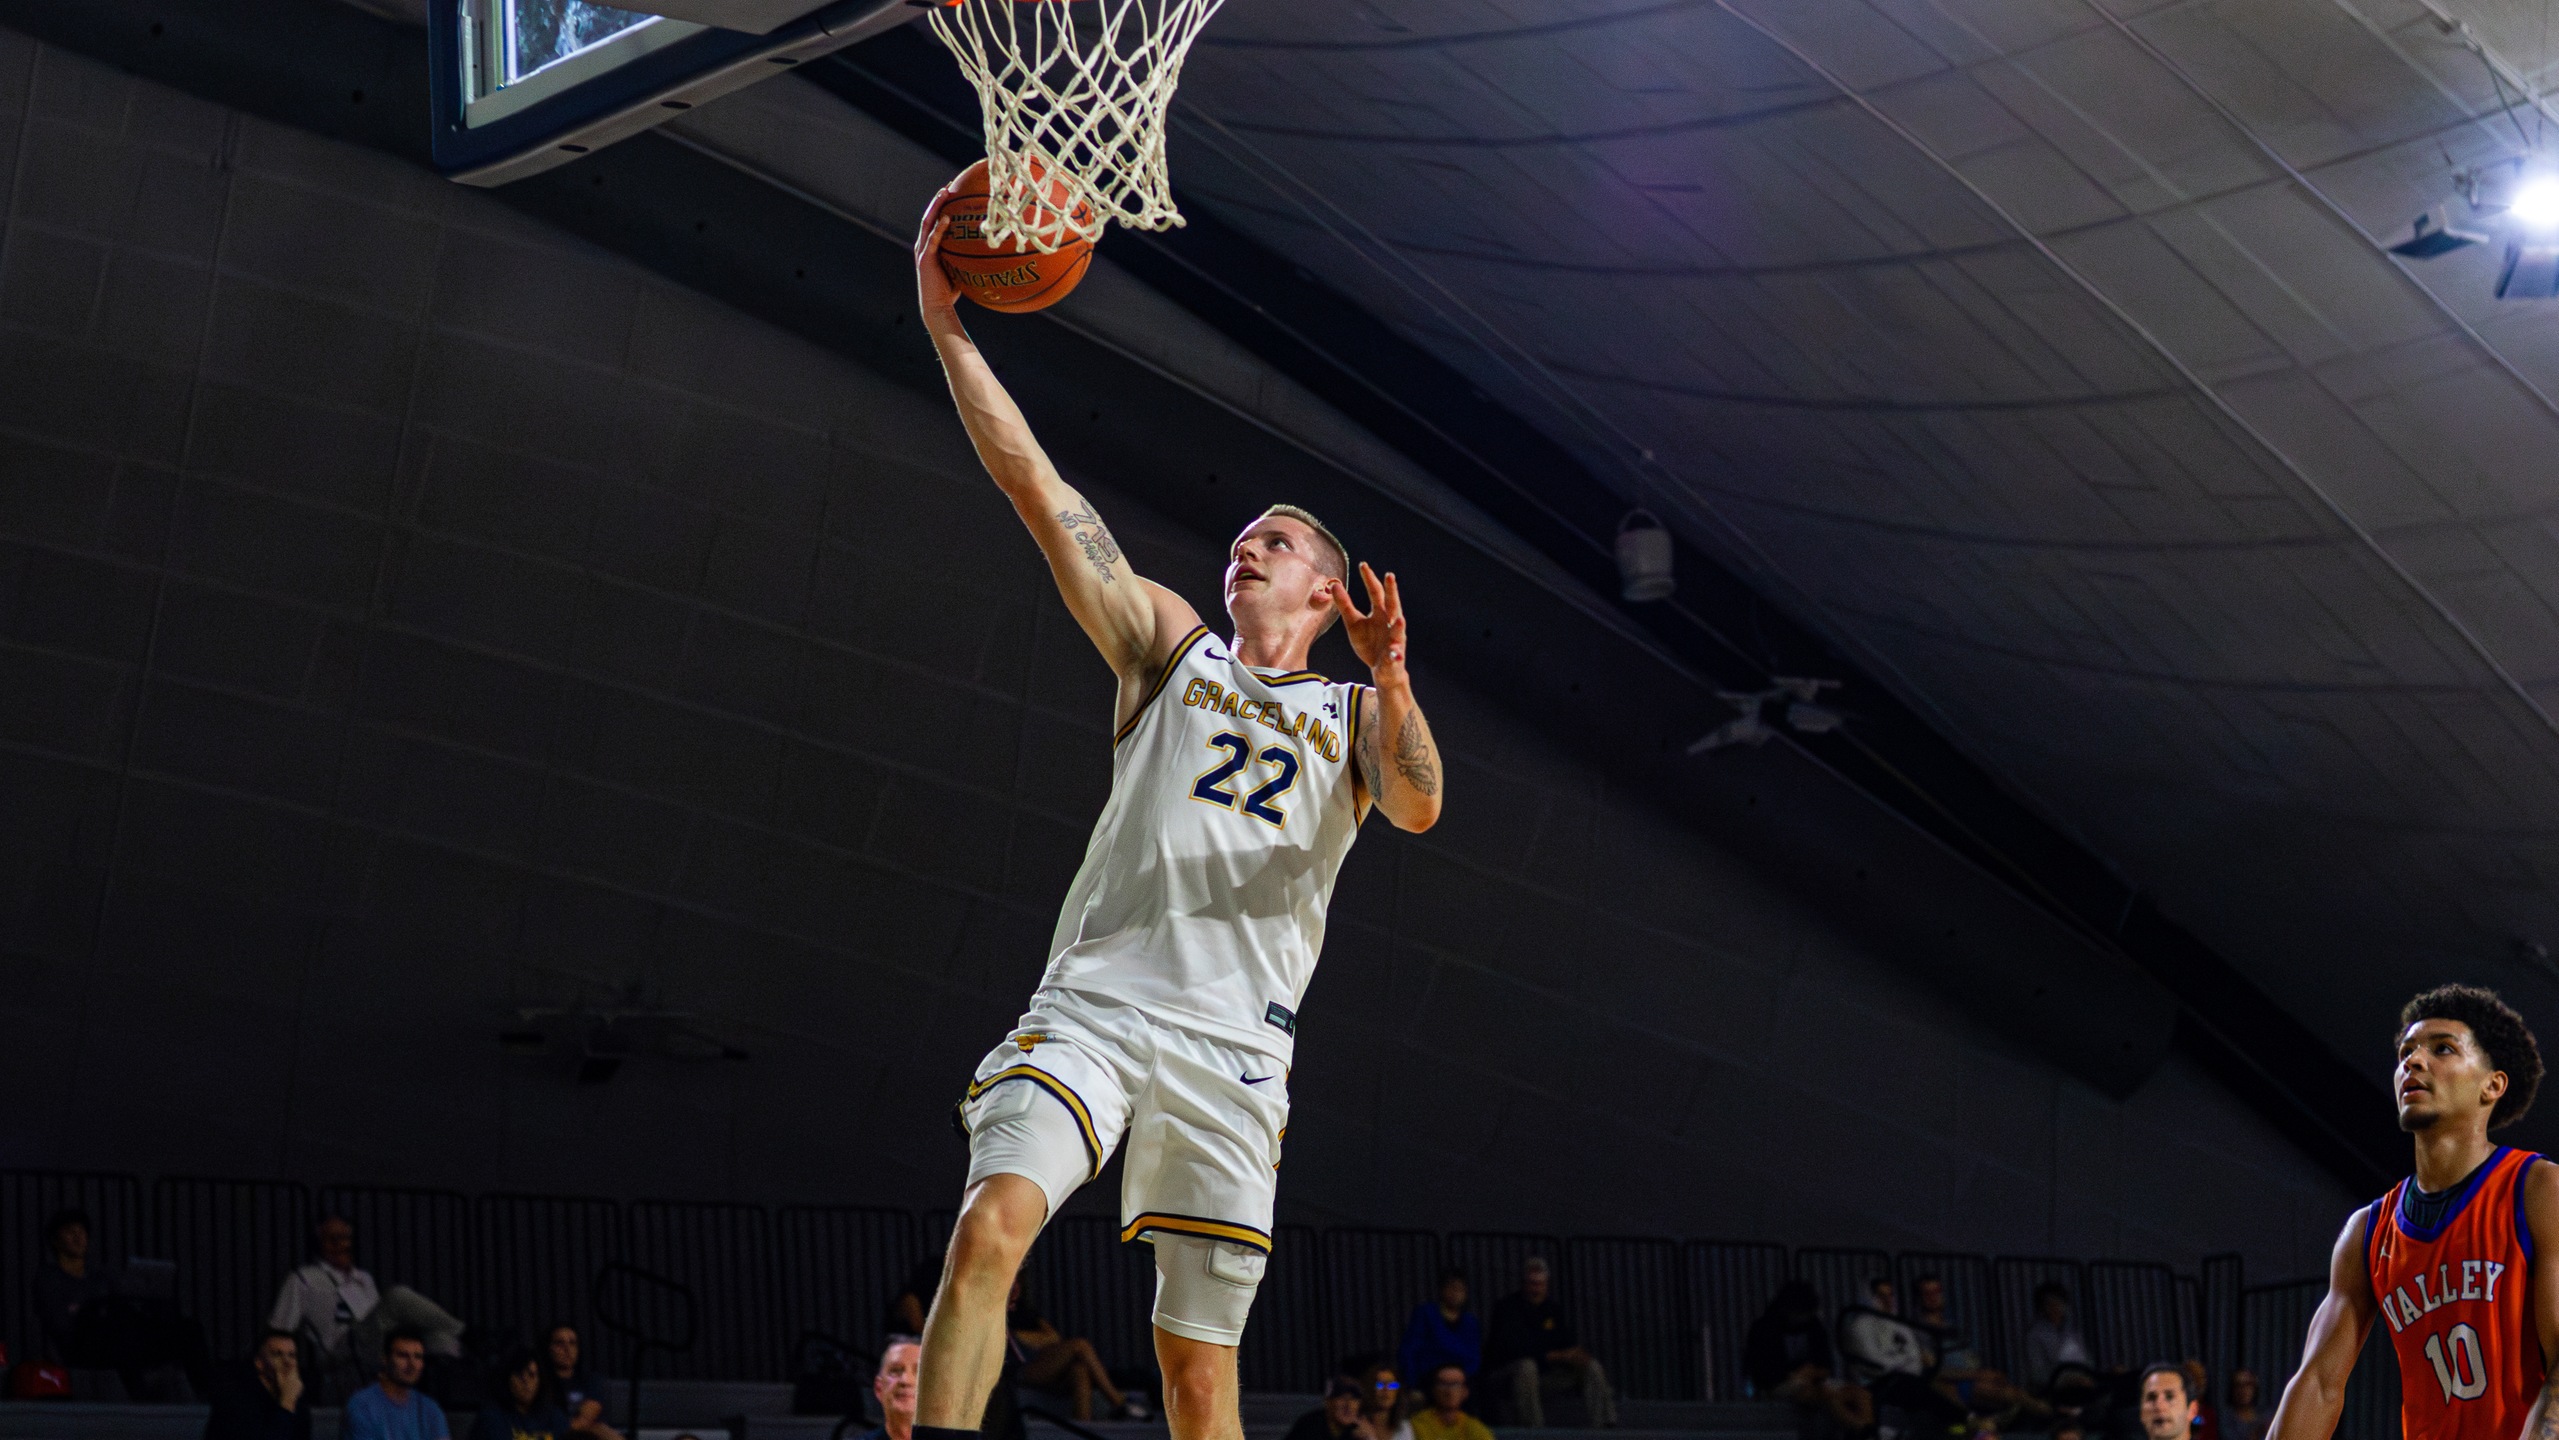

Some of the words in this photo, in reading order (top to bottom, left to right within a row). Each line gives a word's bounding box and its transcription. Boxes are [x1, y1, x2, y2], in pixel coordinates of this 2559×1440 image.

[1183, 677, 1341, 764] GRACELAND
[1188, 729, 1303, 831] 22
[2382, 1259, 2505, 1334] VALLEY
[2424, 1322, 2488, 1406] 10
